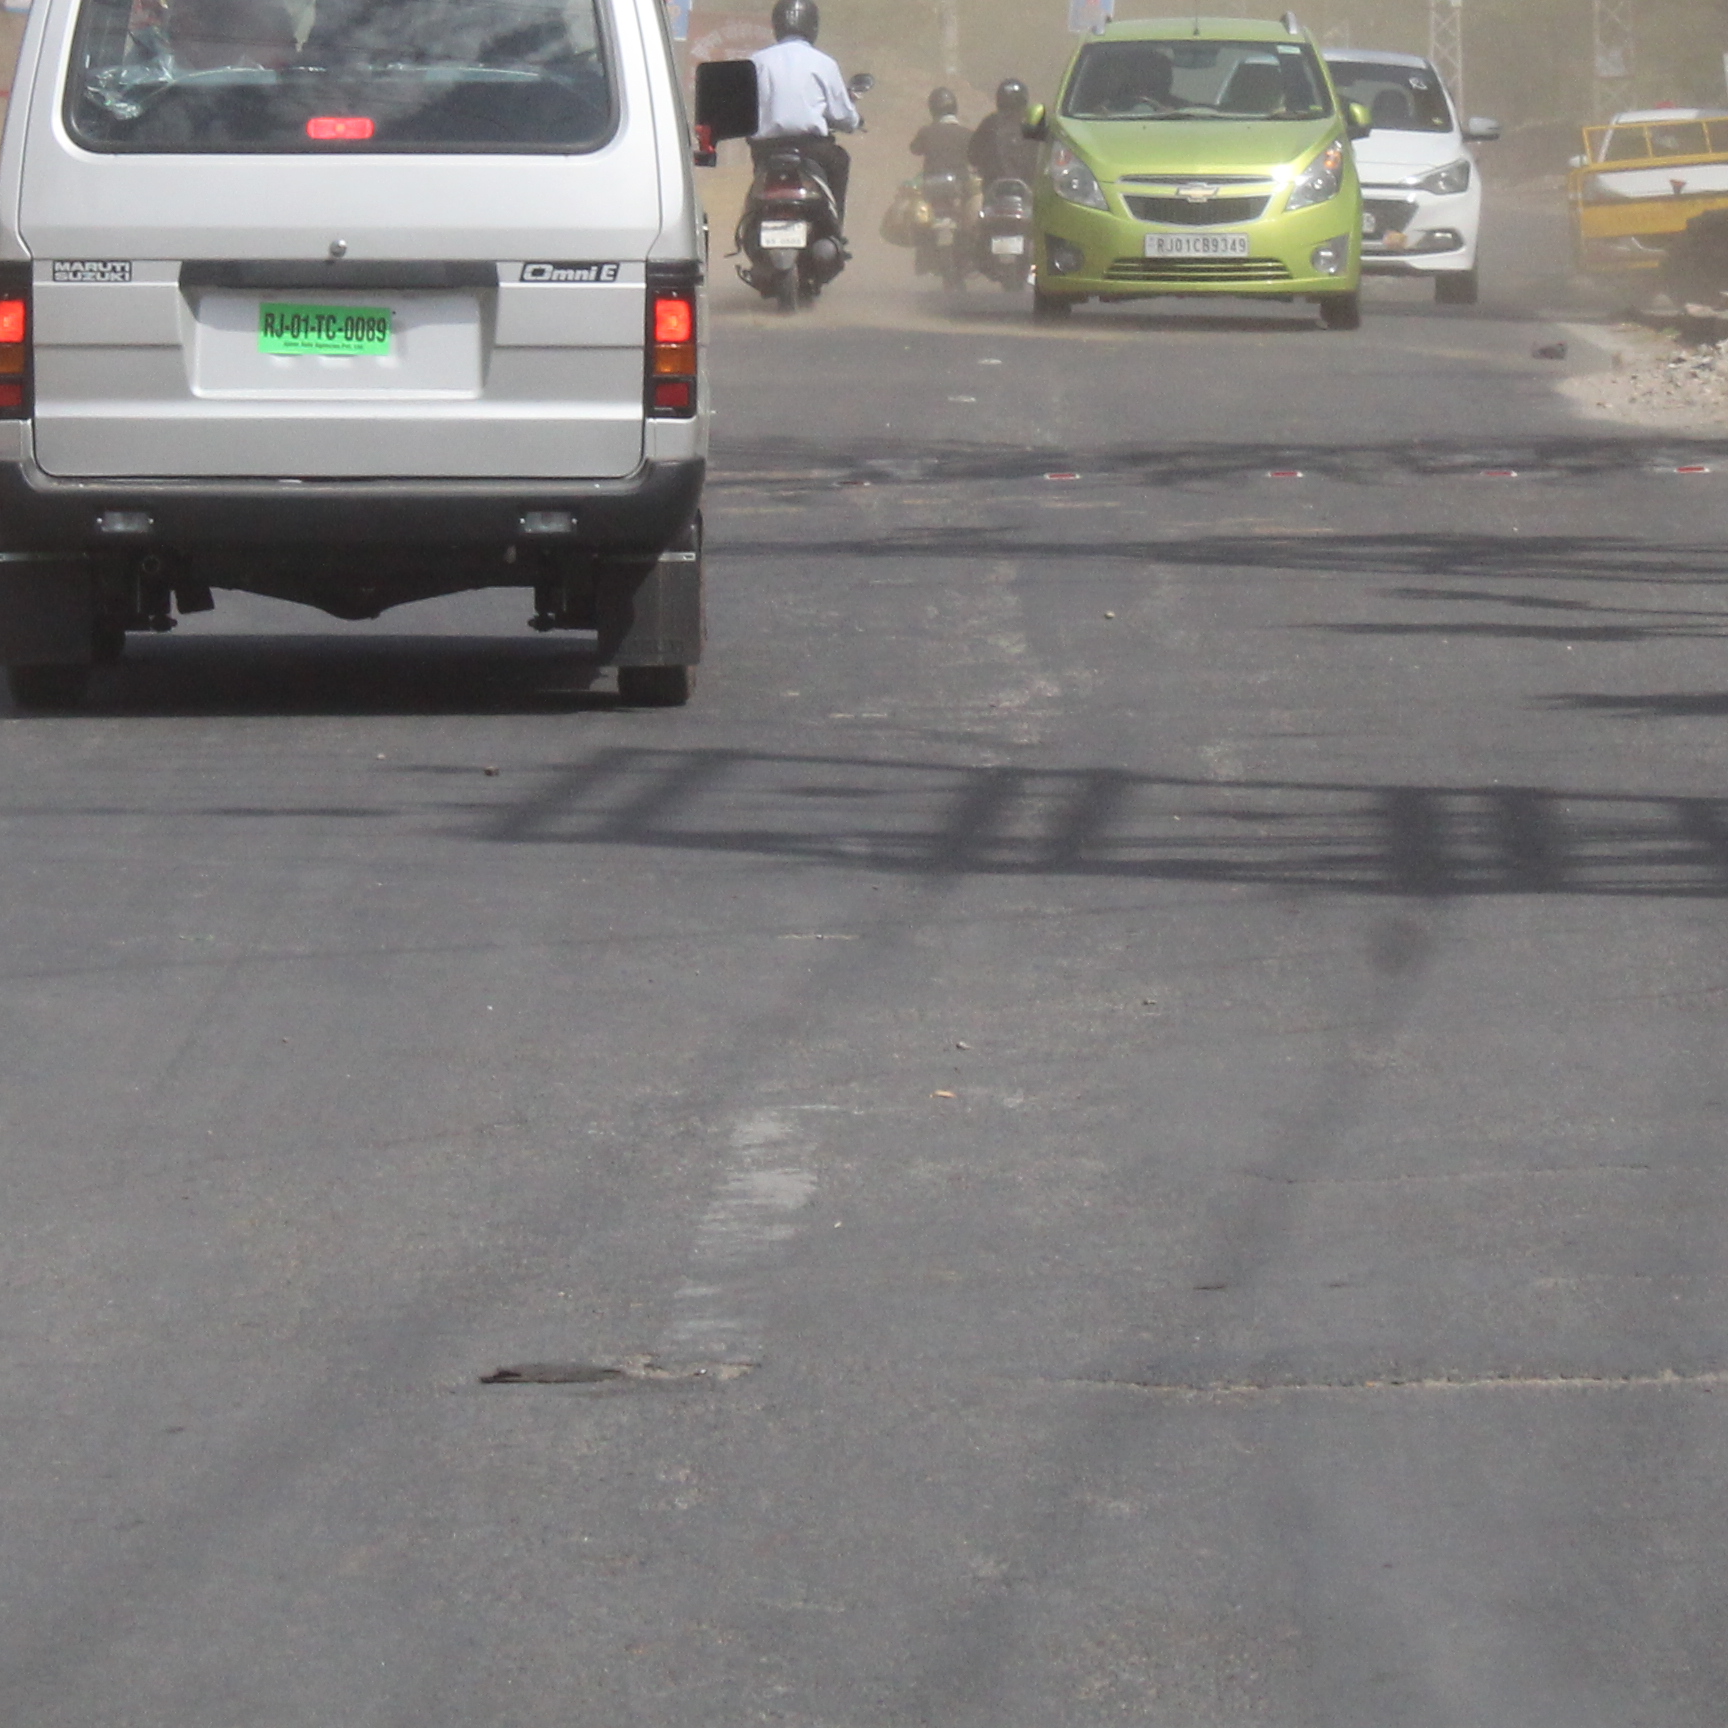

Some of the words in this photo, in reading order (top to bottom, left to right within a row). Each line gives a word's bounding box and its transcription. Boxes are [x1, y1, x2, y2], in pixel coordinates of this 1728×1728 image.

[1156, 237, 1247, 253] RJ01CB9349
[54, 261, 130, 272] MARUTI
[522, 263, 598, 281] Omni
[599, 263, 618, 281] E
[54, 272, 130, 282] SUZUKI
[263, 313, 387, 342] RJ-01-TC-0089
